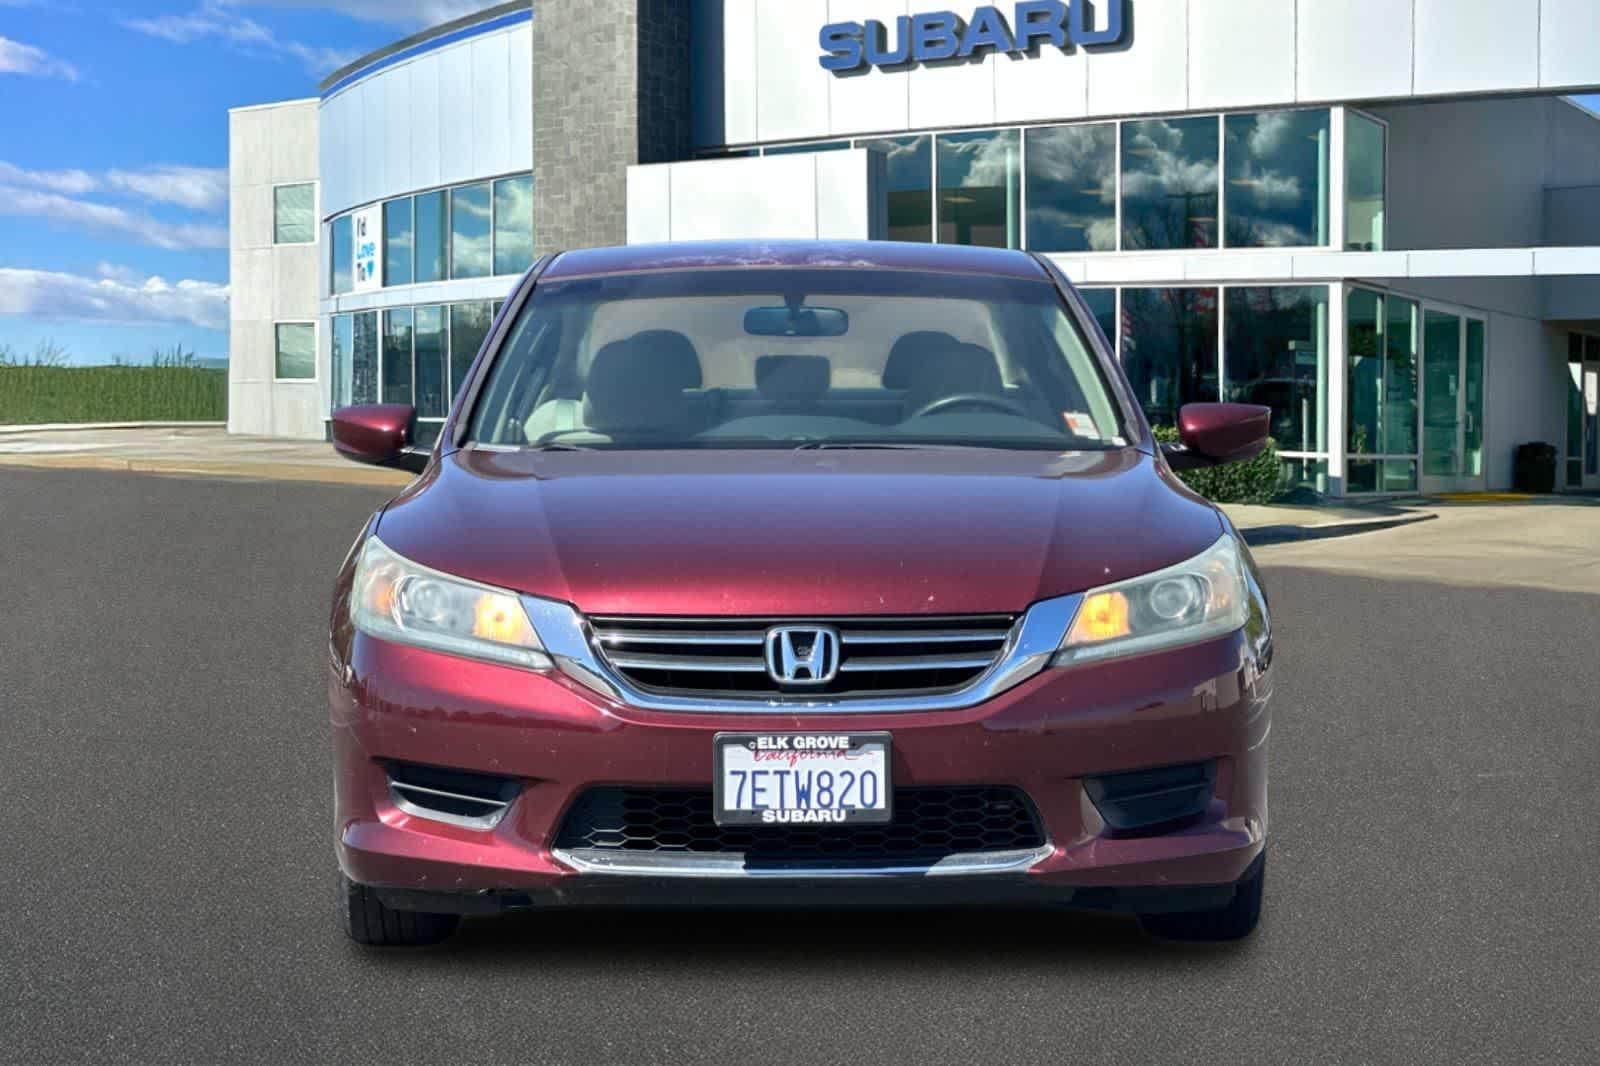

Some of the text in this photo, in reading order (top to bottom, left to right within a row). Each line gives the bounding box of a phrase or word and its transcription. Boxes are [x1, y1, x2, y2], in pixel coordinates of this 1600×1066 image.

[819, 0, 1130, 75] SUBARU
[757, 736, 849, 750] ELK GROVE
[730, 770, 878, 809] 7ETW820
[762, 809, 847, 823] SUBARU
